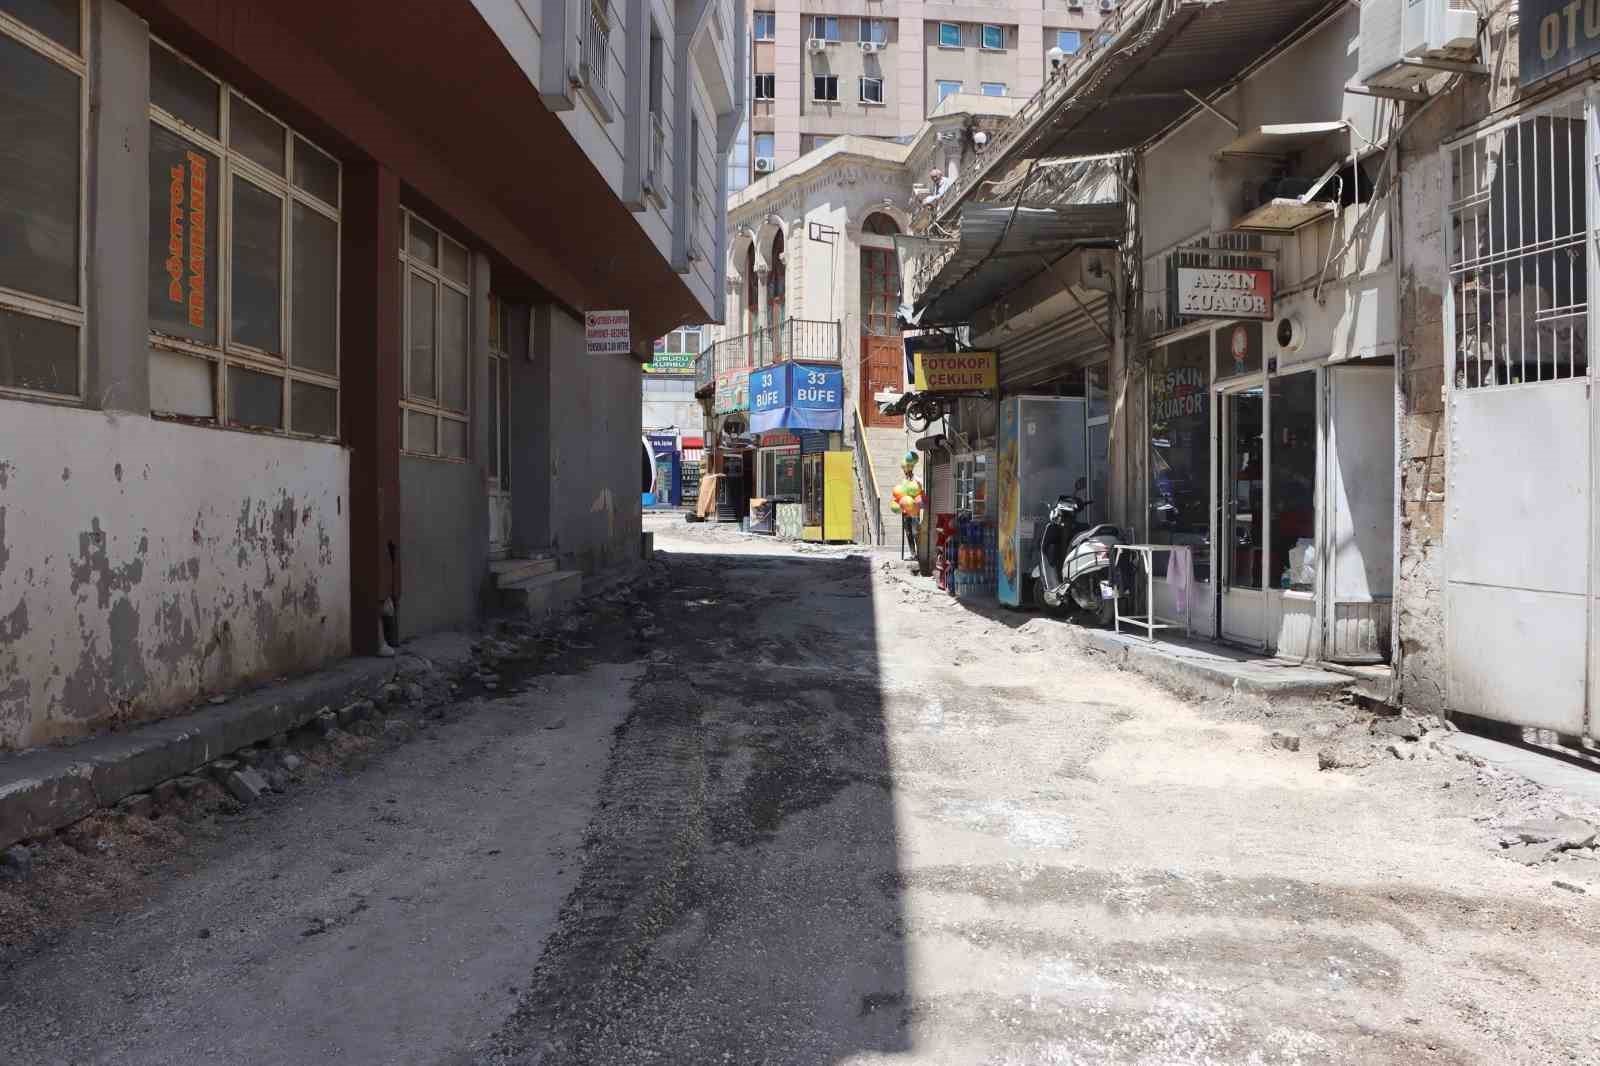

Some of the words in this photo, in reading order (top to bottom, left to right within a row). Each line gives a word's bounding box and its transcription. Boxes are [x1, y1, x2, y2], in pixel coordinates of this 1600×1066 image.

[1194, 271, 1257, 292] AŞKIN
[1183, 291, 1266, 314] KUAFÖR
[761, 373, 773, 387] 33
[807, 372, 826, 385] 33
[756, 390, 779, 407] BÜFE
[798, 386, 836, 402] BÜFE
